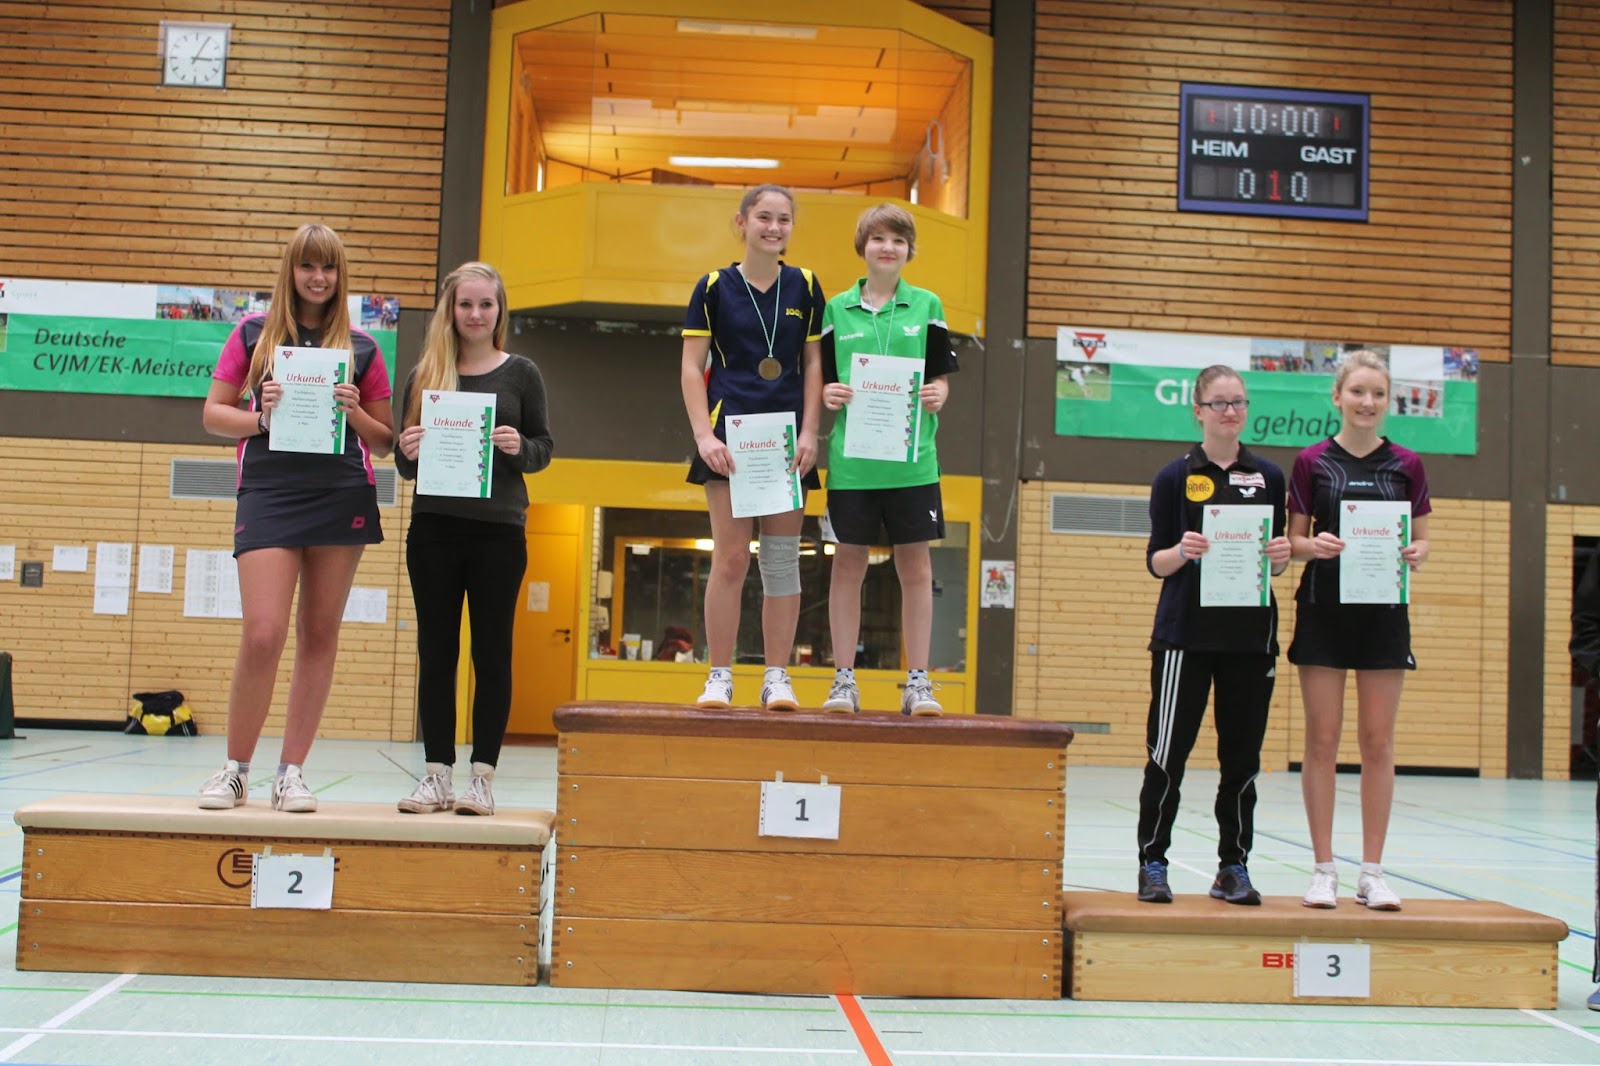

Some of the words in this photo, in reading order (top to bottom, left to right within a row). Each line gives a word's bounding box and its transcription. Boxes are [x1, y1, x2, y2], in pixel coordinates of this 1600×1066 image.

[1232, 103, 1319, 137] 10:00
[1191, 139, 1249, 158] HEIM
[1300, 146, 1357, 164] GAST
[1238, 168, 1256, 199] 0
[1268, 170, 1282, 200] 1
[1290, 171, 1308, 202] 0
[34, 327, 127, 349] Deutsche
[286, 373, 327, 384] Urkunde
[861, 380, 902, 392] Urkunde
[433, 417, 473, 428] Urkunde
[739, 439, 777, 450] Urkunde
[1214, 531, 1252, 541] Urkunde
[1352, 527, 1390, 537] Urkunde
[795, 798, 809, 822] 1
[287, 870, 303, 894] 2
[1326, 954, 1341, 978] 3
